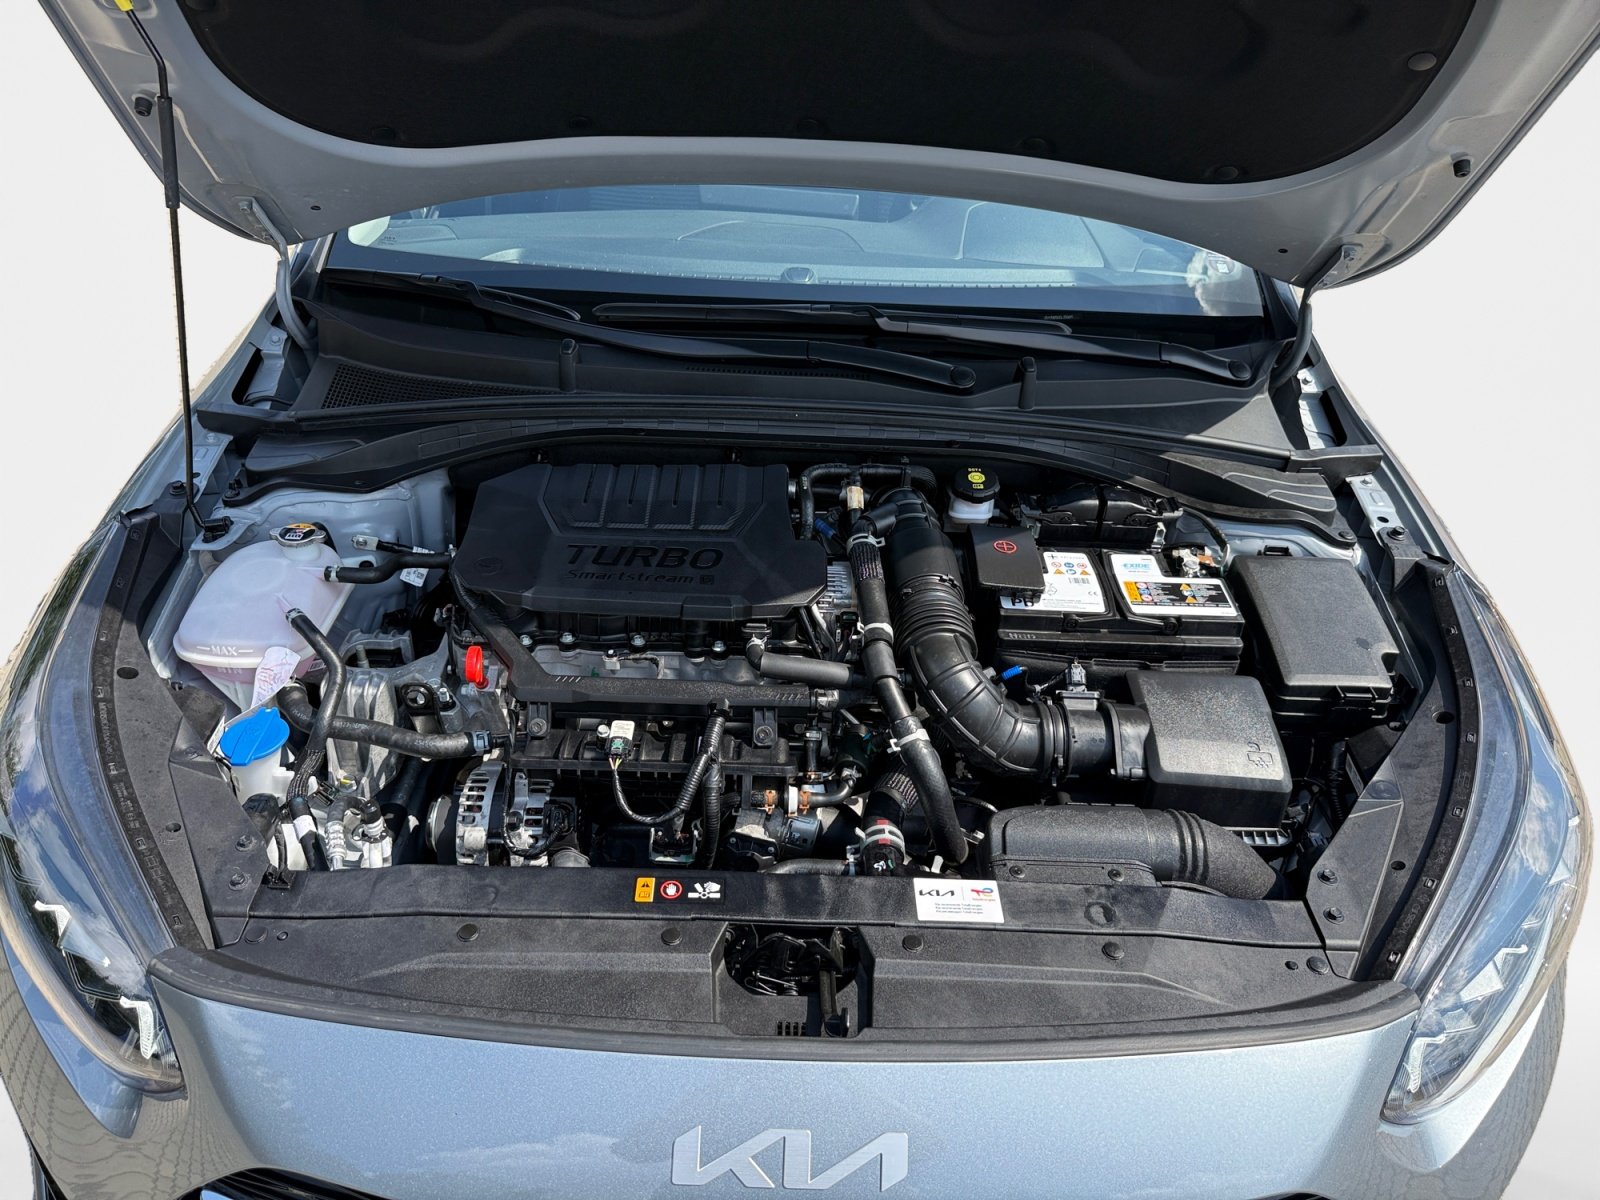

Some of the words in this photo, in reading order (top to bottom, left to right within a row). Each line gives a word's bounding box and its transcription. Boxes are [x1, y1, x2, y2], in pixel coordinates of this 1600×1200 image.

[567, 544, 724, 570] TURBO
[567, 569, 694, 585] Smartstream
[211, 645, 238, 656] MAX
[919, 889, 955, 897] KIA
[671, 1124, 909, 1192] KIA
